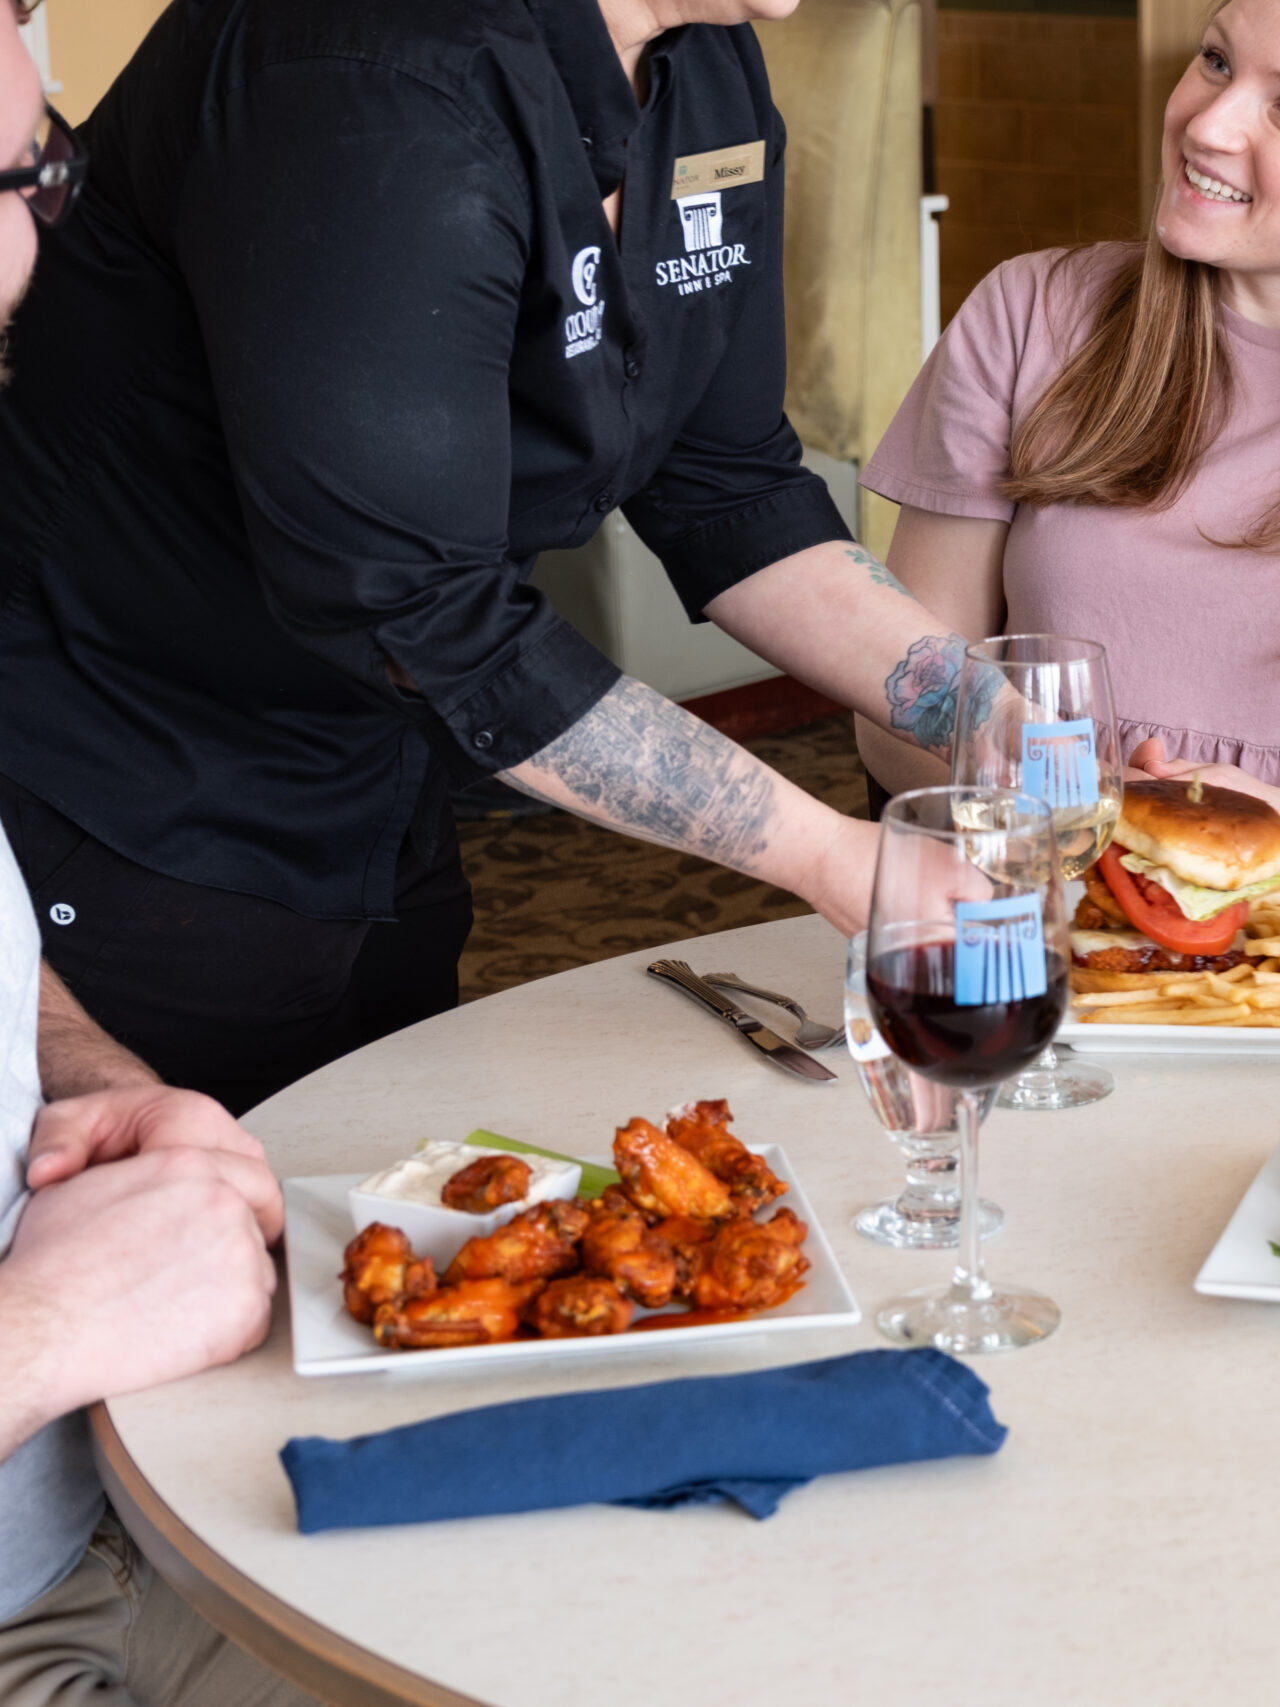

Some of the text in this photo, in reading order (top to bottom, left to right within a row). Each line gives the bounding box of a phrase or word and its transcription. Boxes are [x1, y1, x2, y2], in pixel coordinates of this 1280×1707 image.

[673, 174, 700, 185] NATOR
[714, 165, 746, 180] Missy
[655, 243, 752, 286] SENATOR
[678, 279, 703, 296] INN
[714, 270, 733, 286] SPA
